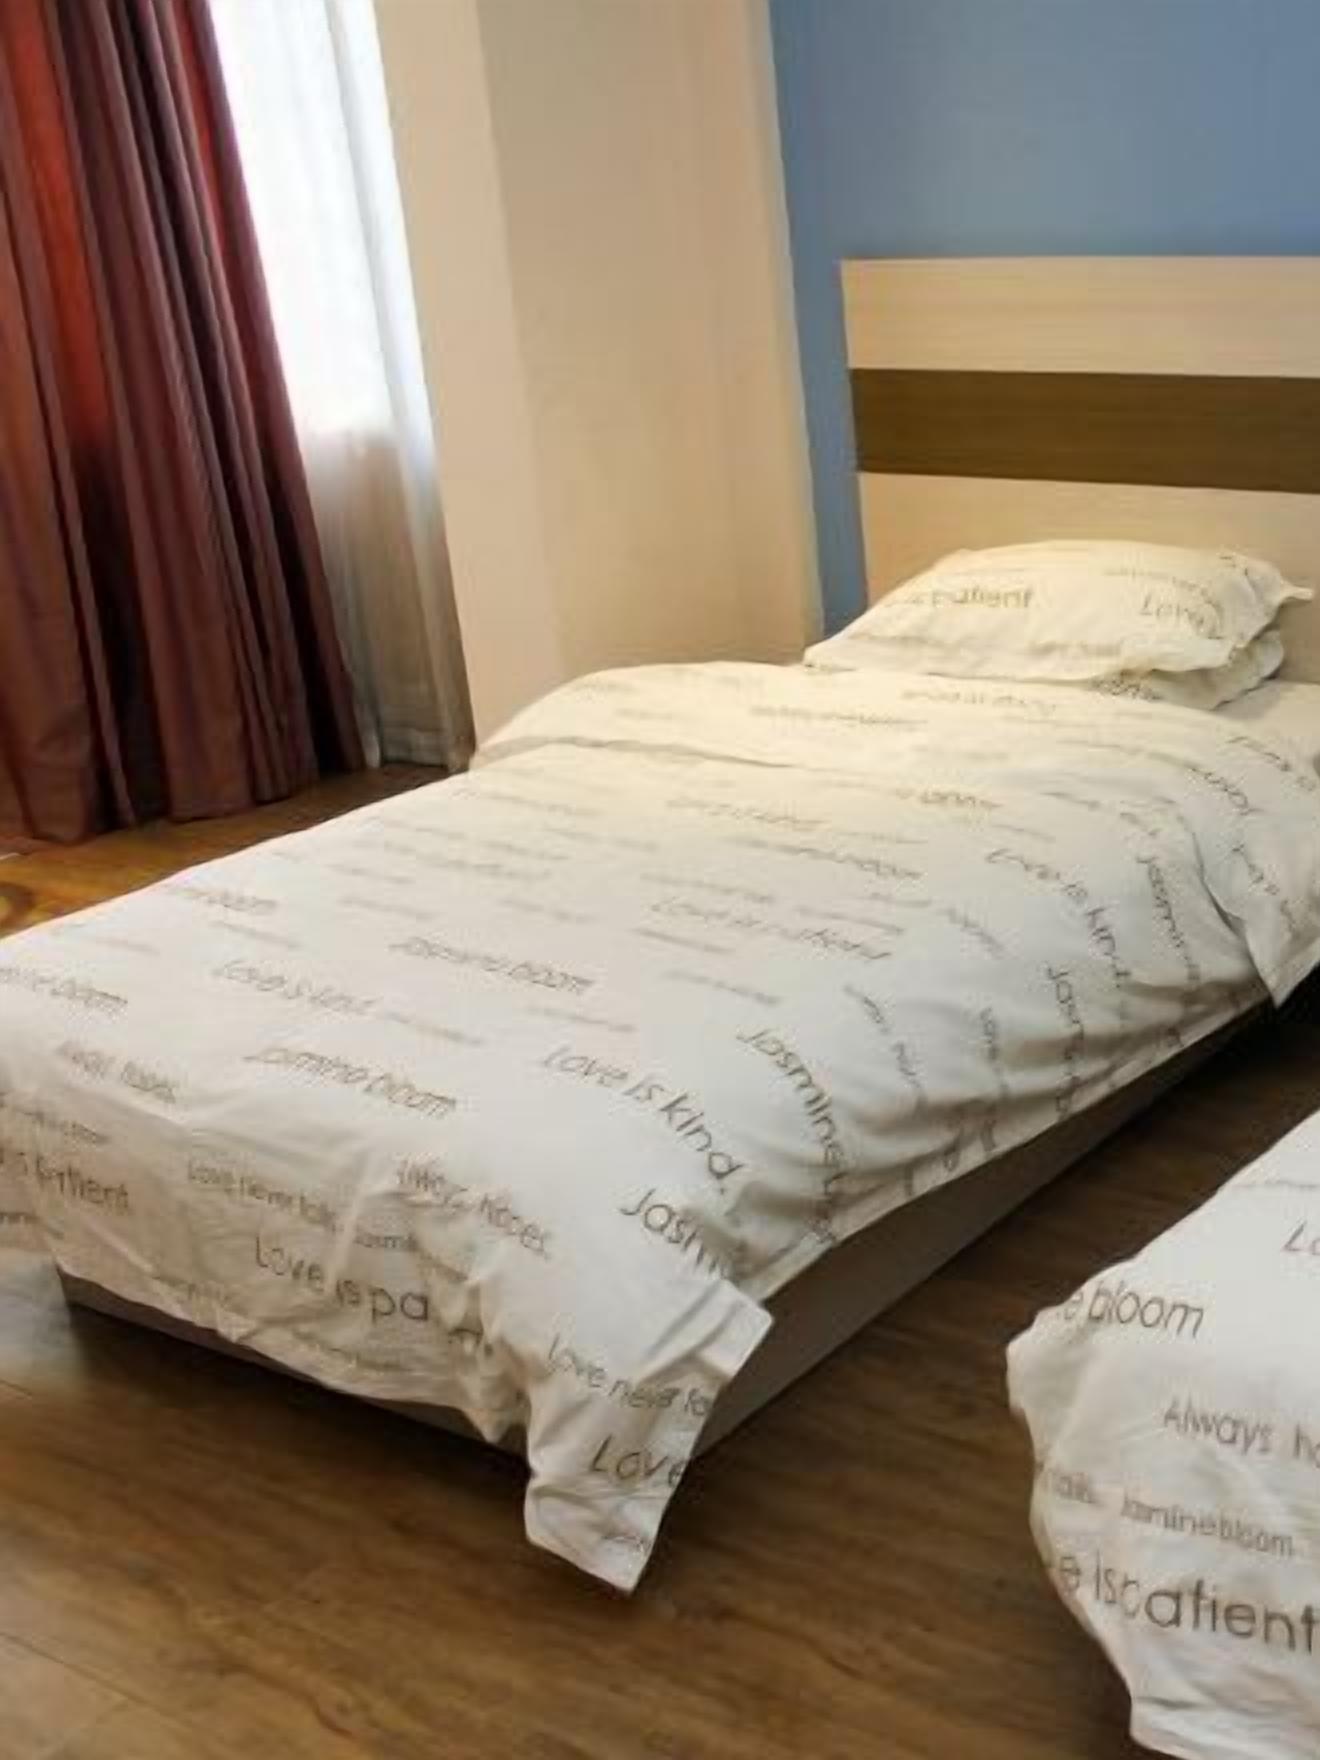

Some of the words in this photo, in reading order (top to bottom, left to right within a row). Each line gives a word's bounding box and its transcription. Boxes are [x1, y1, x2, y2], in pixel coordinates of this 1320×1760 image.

[540, 1042, 630, 1087] Love
[1088, 1280, 1204, 1339] bloom
[1163, 1394, 1273, 1456] Always
